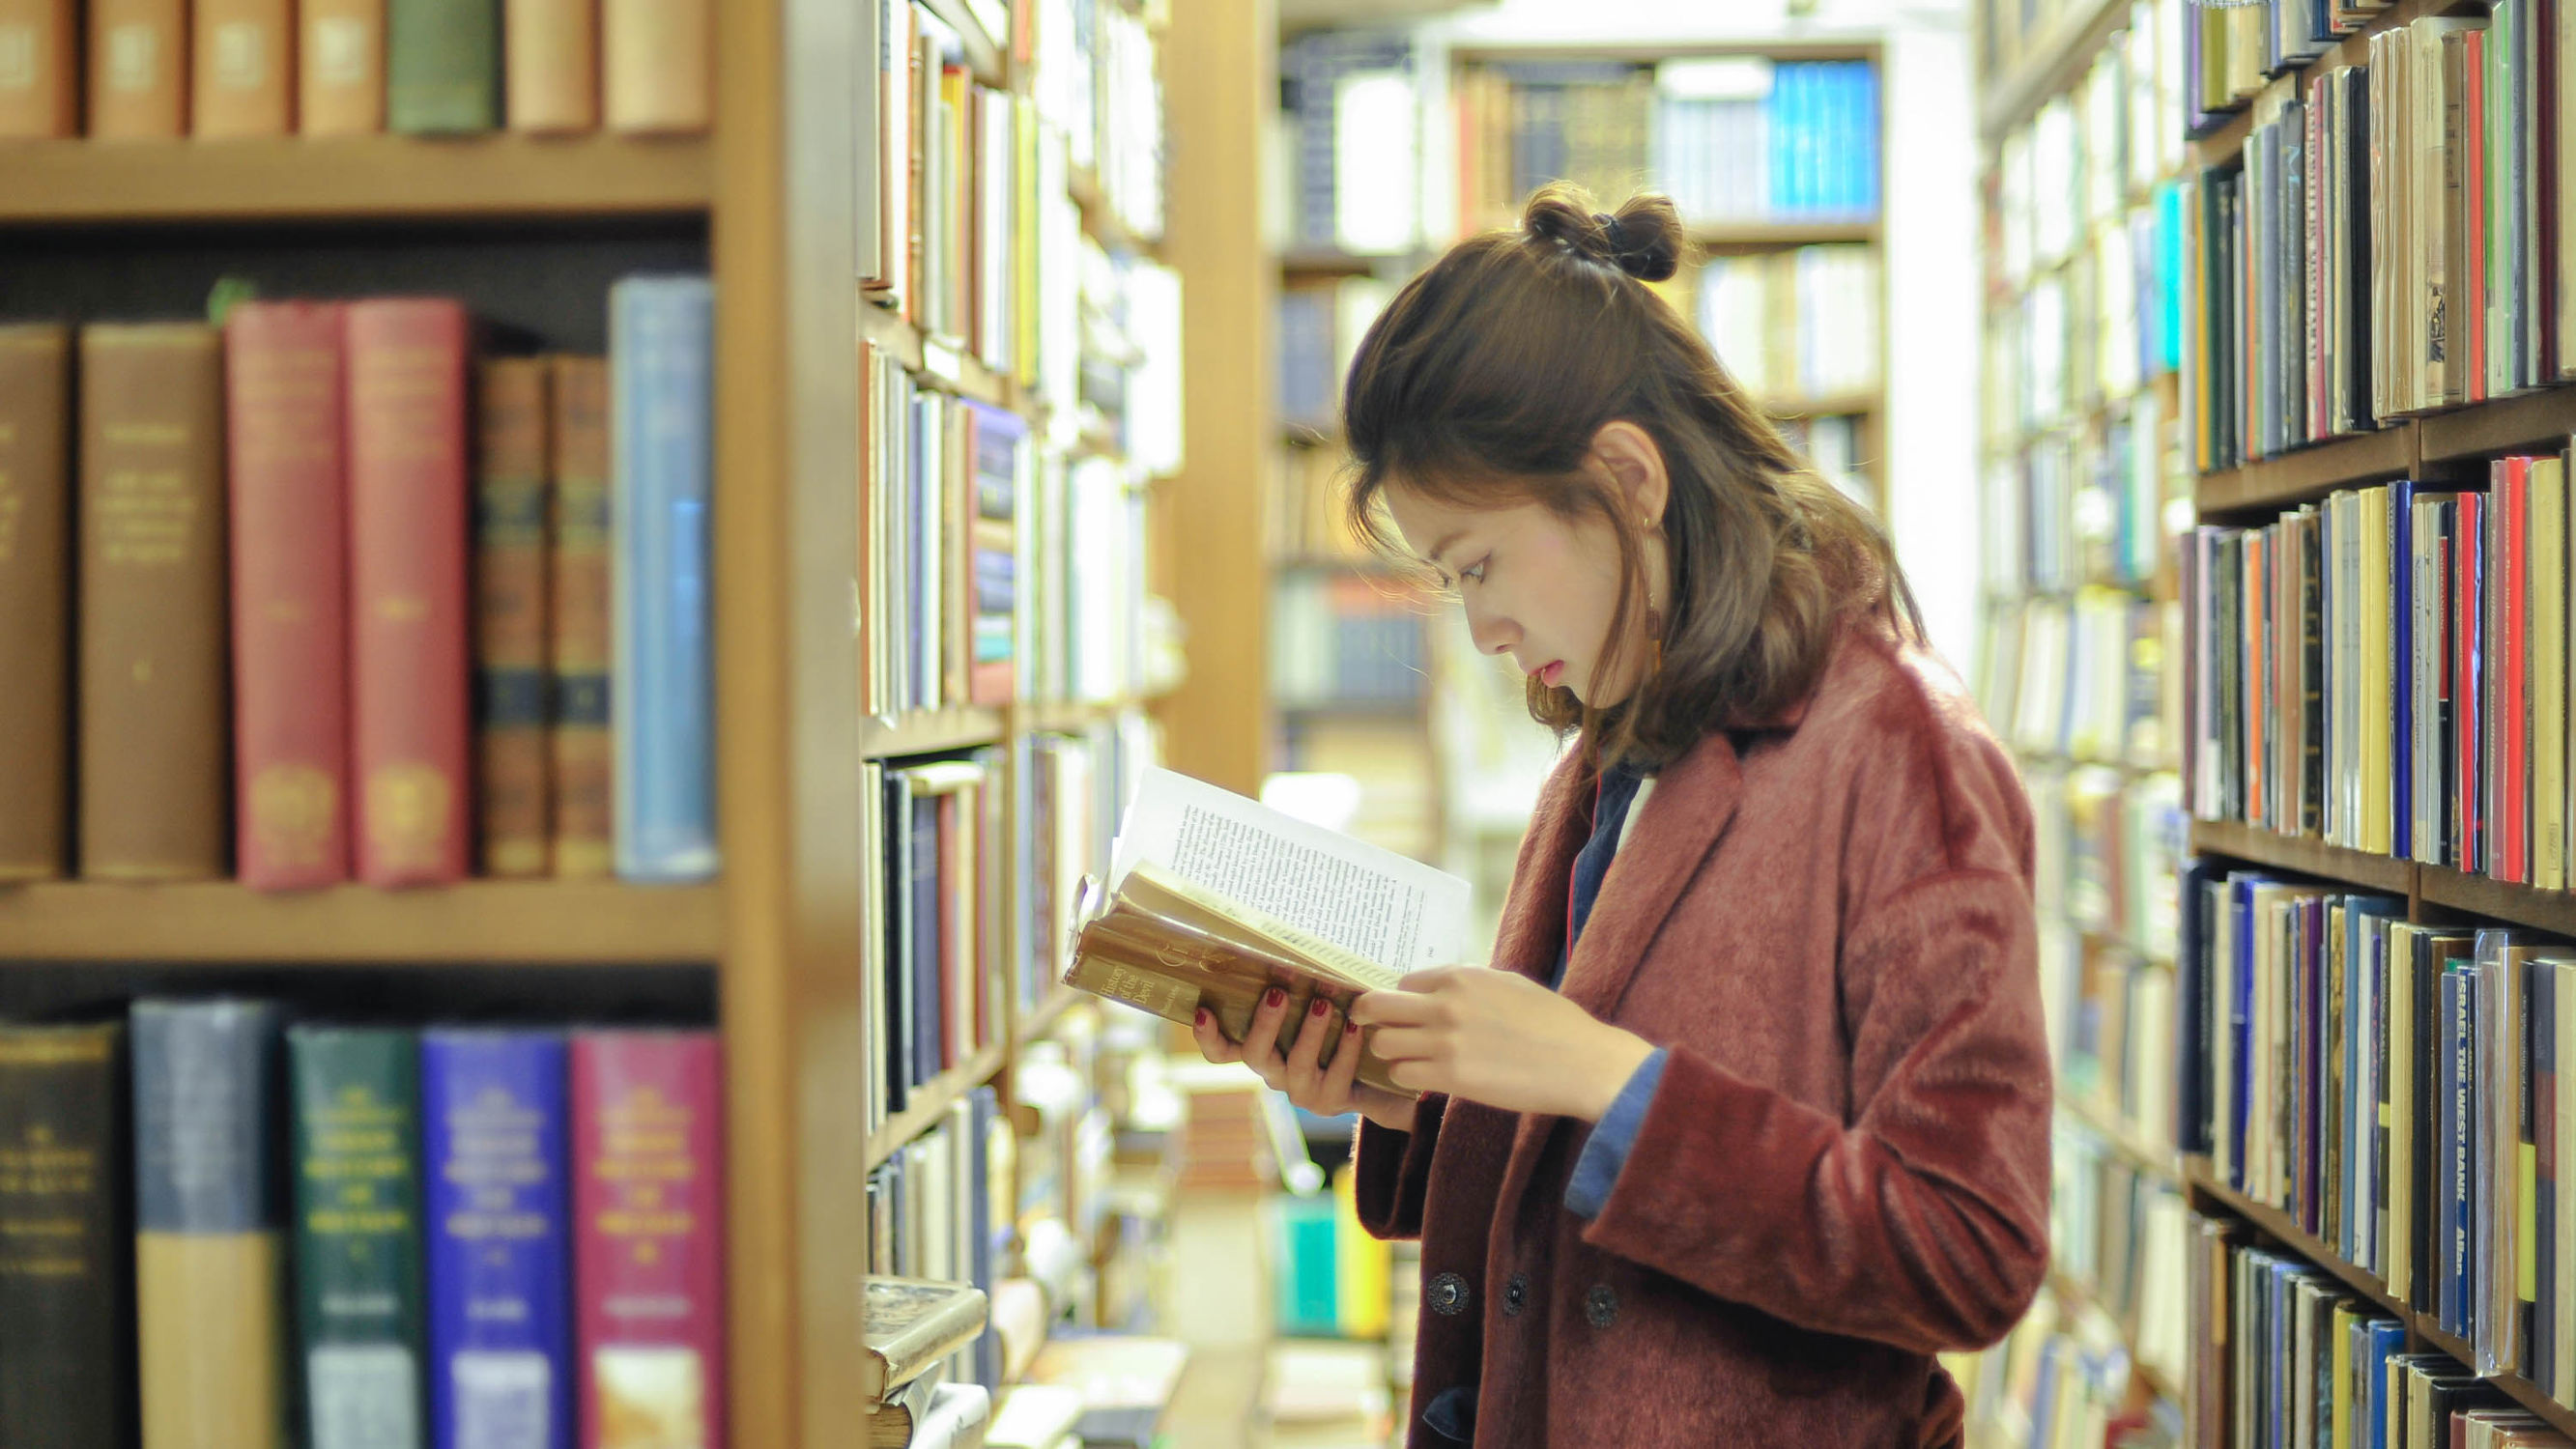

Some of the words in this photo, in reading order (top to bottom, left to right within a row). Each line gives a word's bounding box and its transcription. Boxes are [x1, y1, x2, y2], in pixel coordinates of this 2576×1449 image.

[1100, 965, 1127, 997] History
[1120, 987, 1131, 1000] of
[1122, 975, 1138, 990] the
[1133, 980, 1155, 1004] Devil
[2458, 975, 2468, 1042] ISRAEL
[2457, 1046, 2467, 1084] THE
[2457, 1088, 2467, 1145] WEST
[2457, 1146, 2467, 1203] BANK
[2456, 1225, 2465, 1276] Allan
